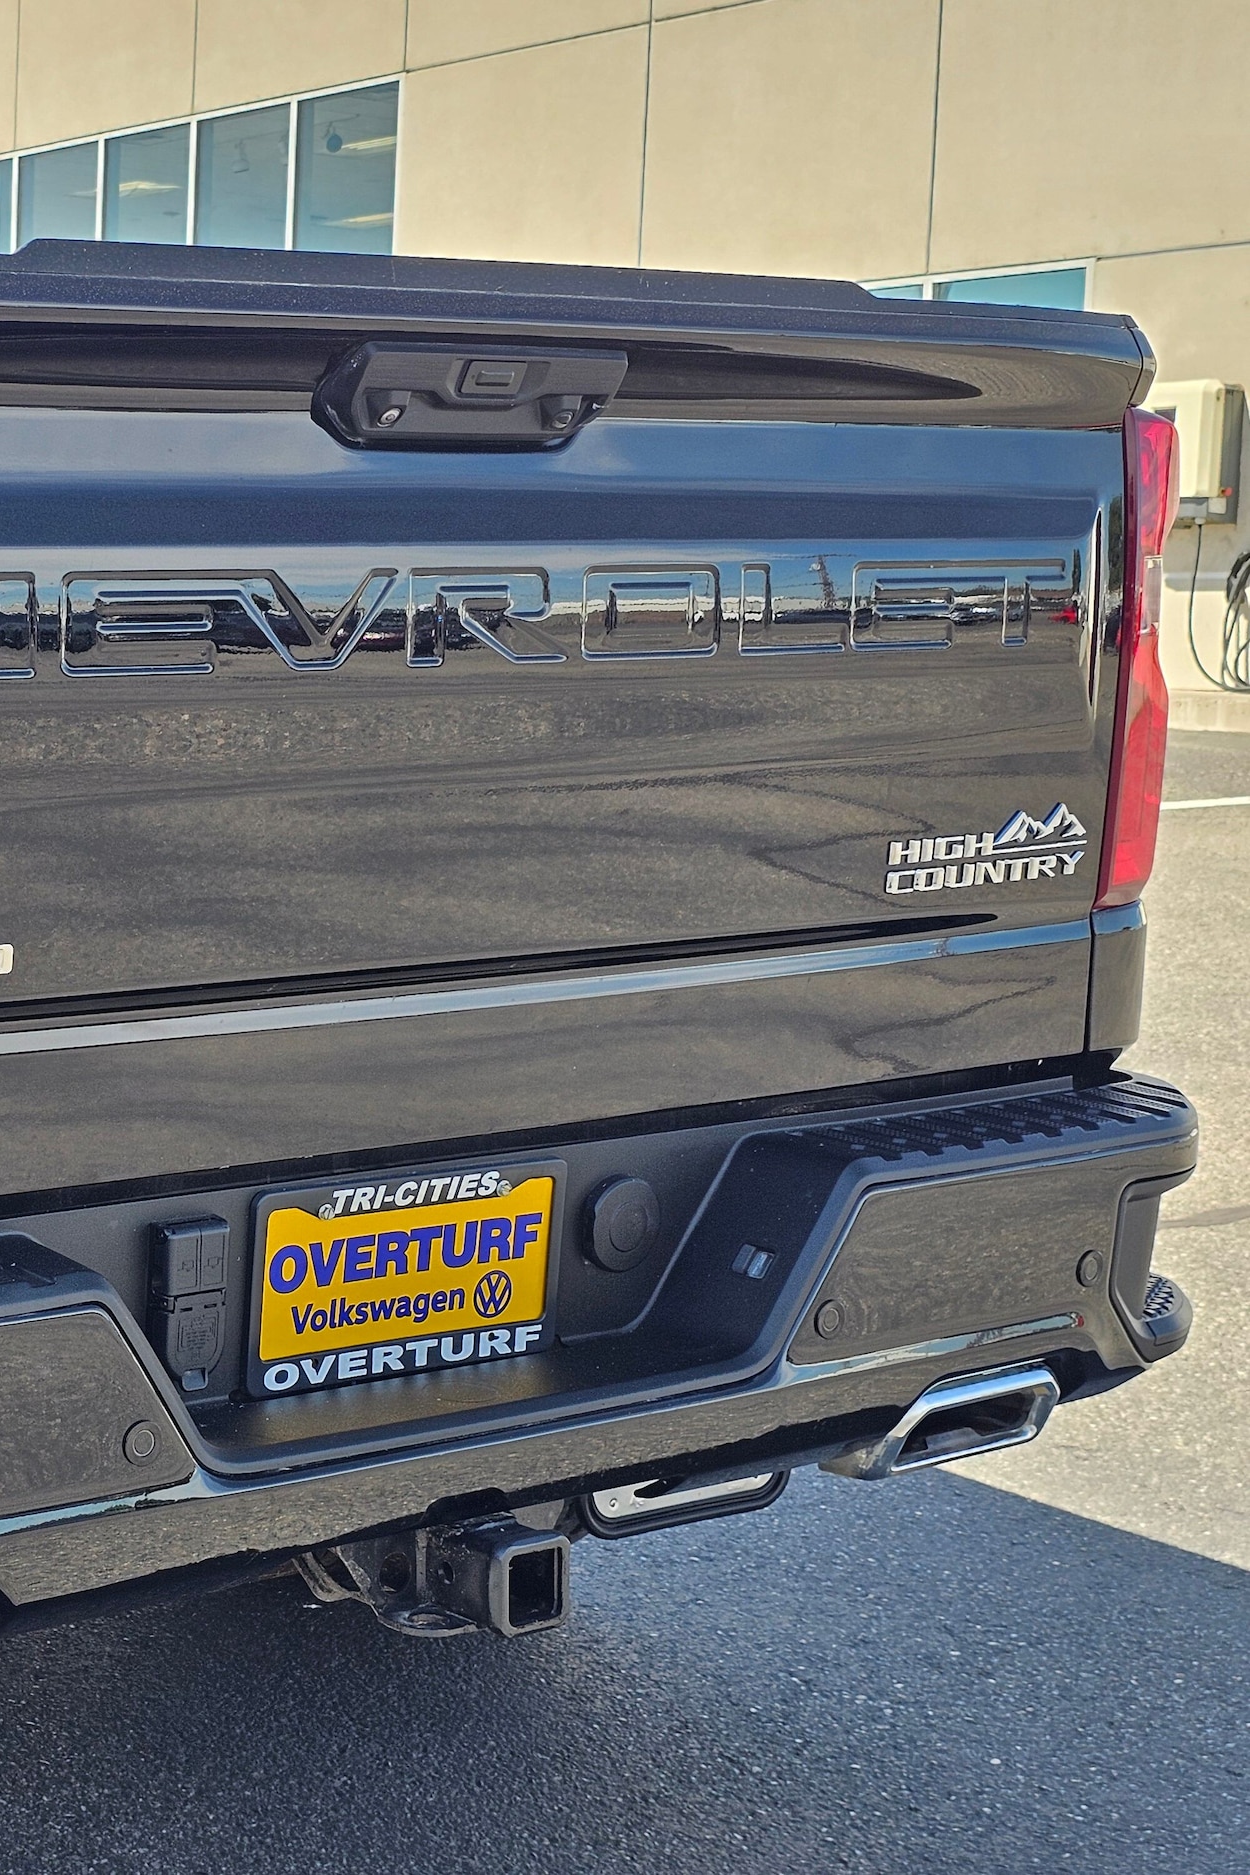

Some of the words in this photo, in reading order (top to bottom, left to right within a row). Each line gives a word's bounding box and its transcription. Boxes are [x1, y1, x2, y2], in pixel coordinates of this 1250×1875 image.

[888, 832, 994, 865] HIGH
[885, 850, 1086, 894] COUNTRY
[333, 1170, 500, 1214] TRI-CITIES
[268, 1212, 543, 1294] OVERTURF
[291, 1287, 465, 1335] Volkswagen
[263, 1324, 543, 1392] OVERTURF
